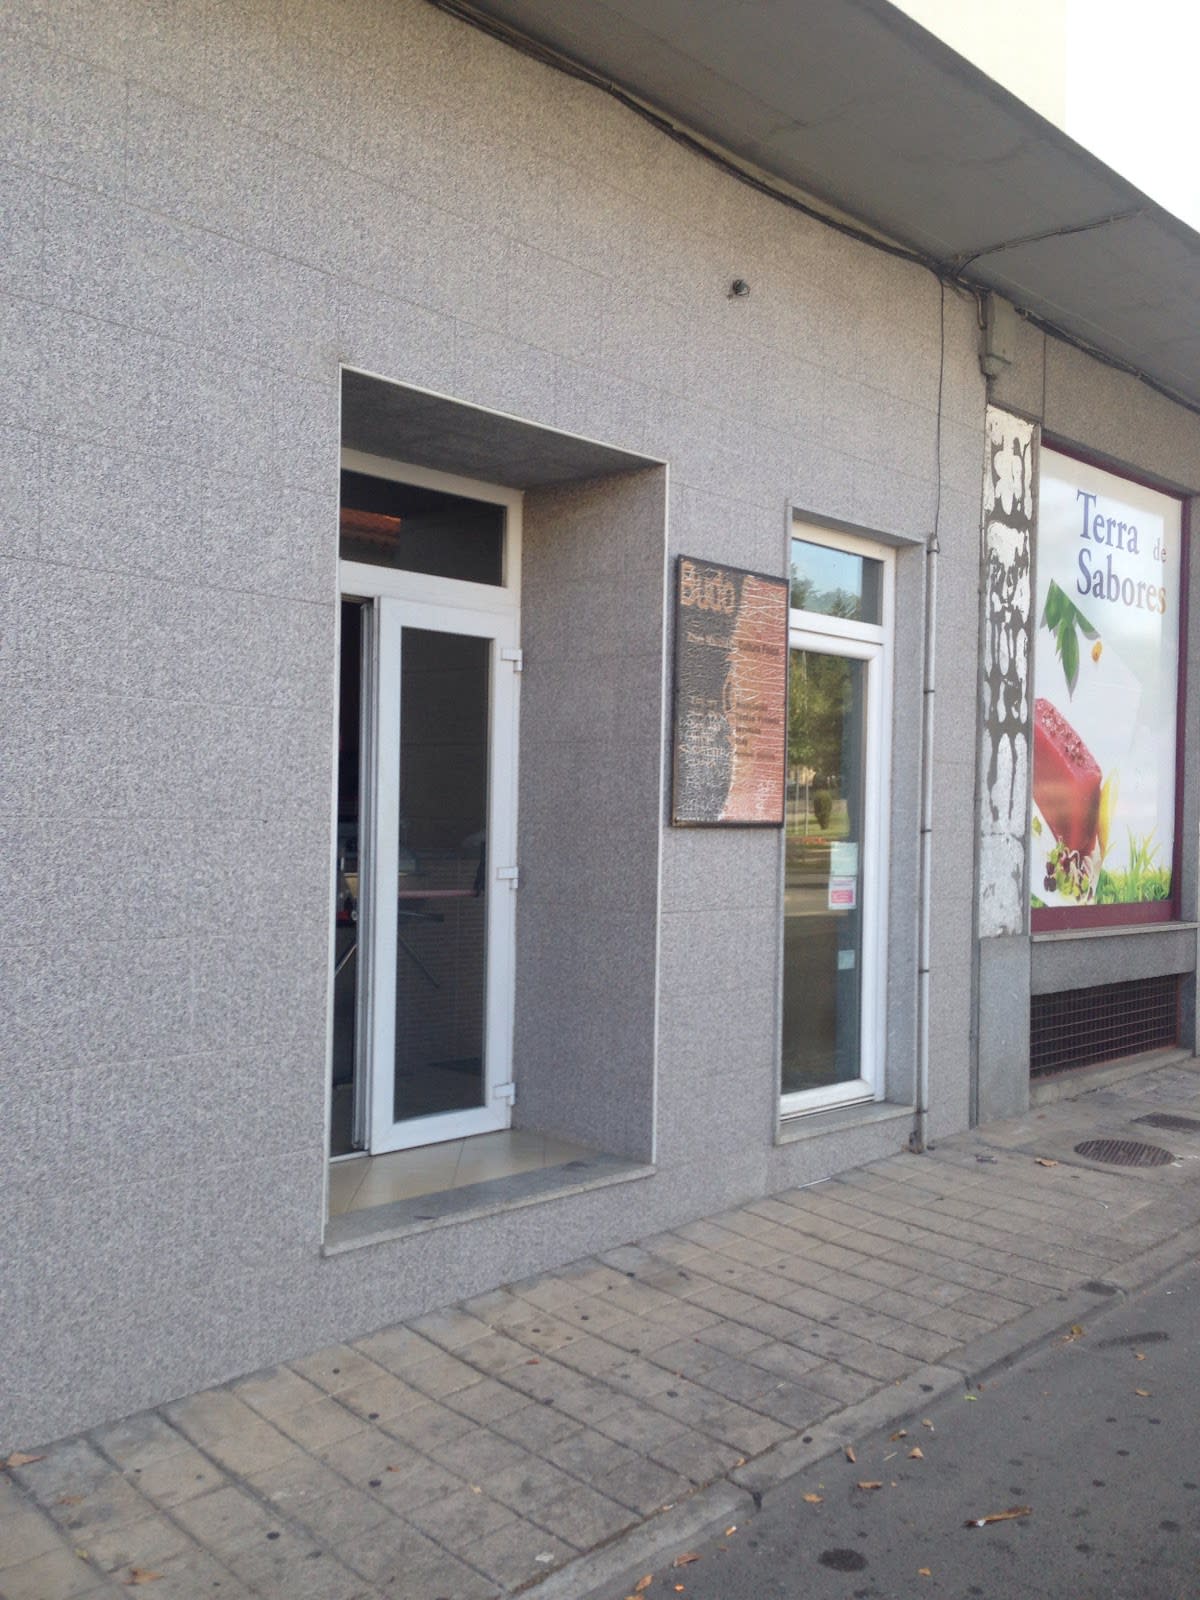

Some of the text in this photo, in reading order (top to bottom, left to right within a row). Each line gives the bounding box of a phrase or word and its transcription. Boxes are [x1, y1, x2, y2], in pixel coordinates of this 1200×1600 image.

[1076, 488, 1167, 563] Terra de
[1076, 547, 1167, 615] Sabores
